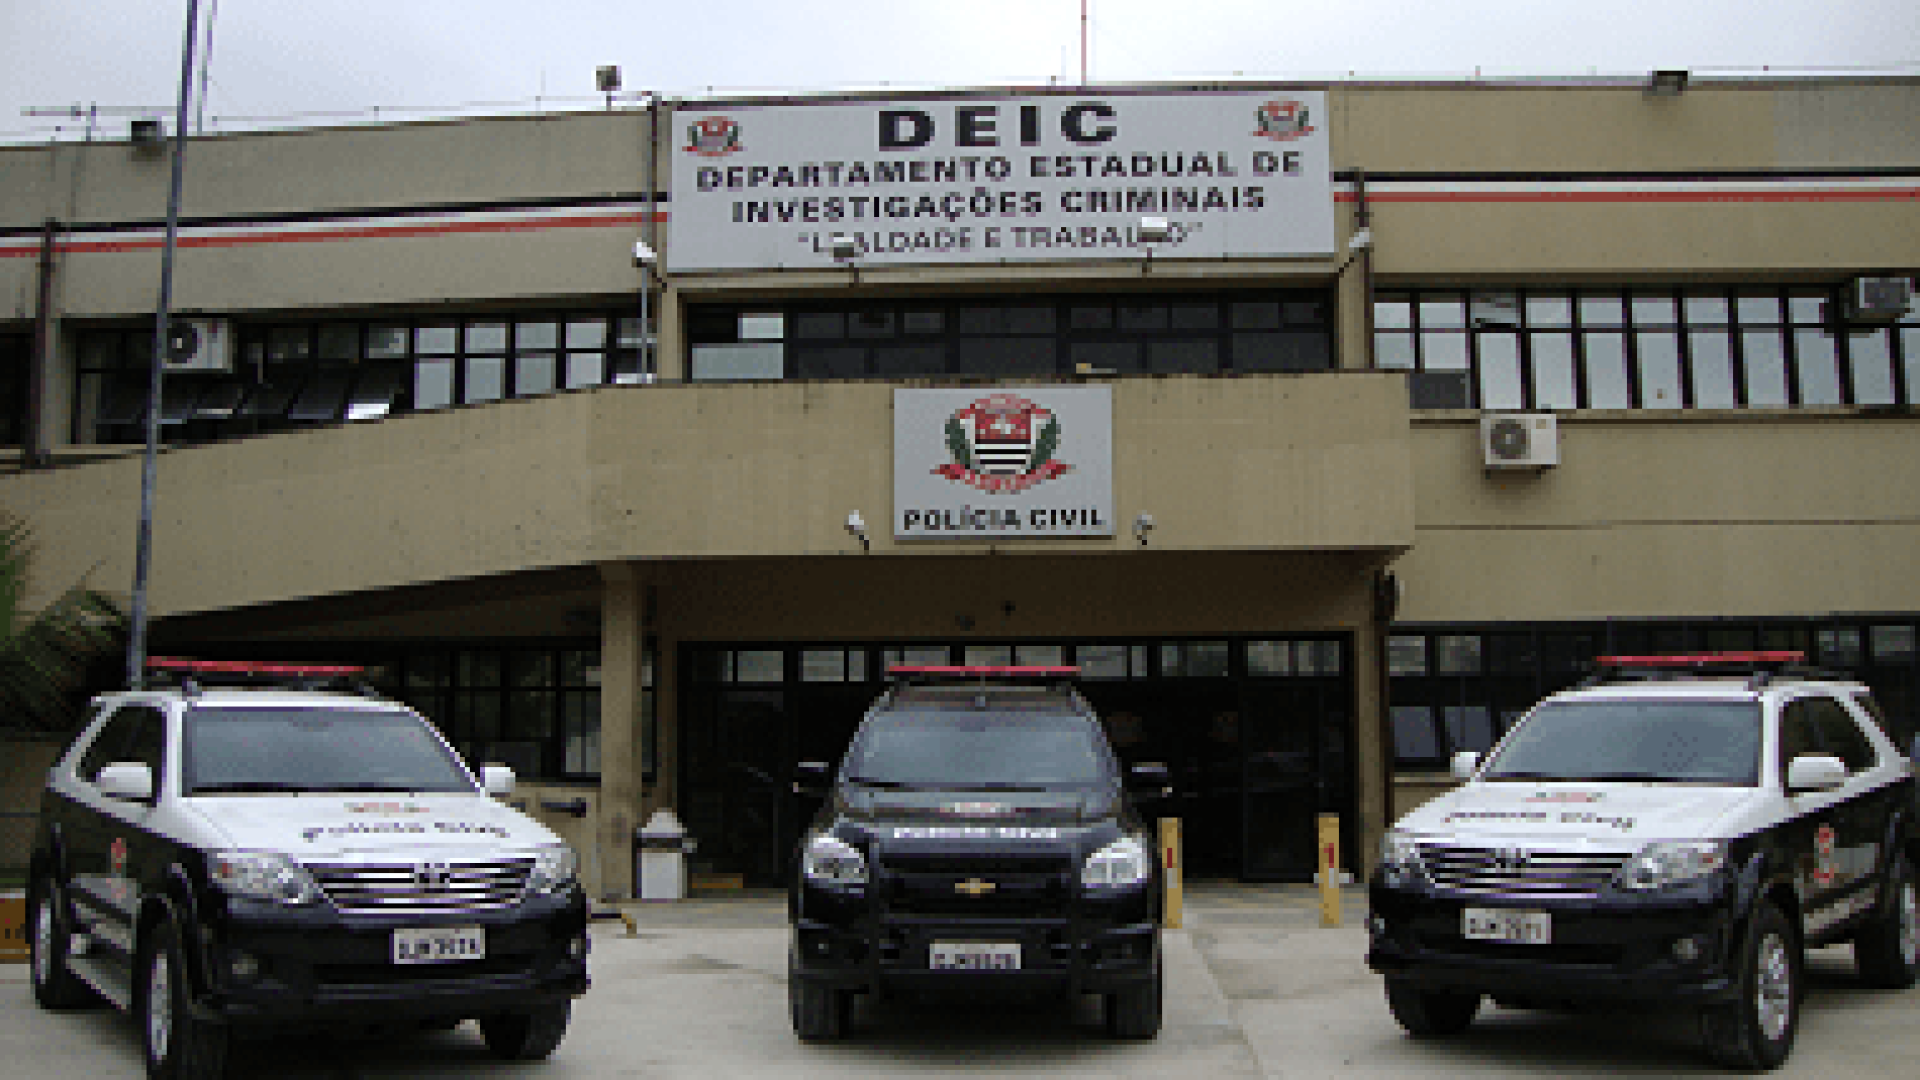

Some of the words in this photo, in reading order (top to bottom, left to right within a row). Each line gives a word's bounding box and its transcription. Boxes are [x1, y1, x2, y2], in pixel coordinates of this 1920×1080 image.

[878, 102, 1118, 149] DEIC
[696, 156, 1011, 192] DEPARTAMENTO
[1029, 152, 1238, 178] ESTADUAL
[1252, 151, 1303, 175] DE
[732, 186, 1042, 223] INVESTIGAÇÕES
[1060, 186, 1266, 213] CRIMINAIS
[984, 226, 1001, 250] E
[904, 505, 1021, 530] POLÍCIA
[1030, 508, 1107, 530] CIVIL
